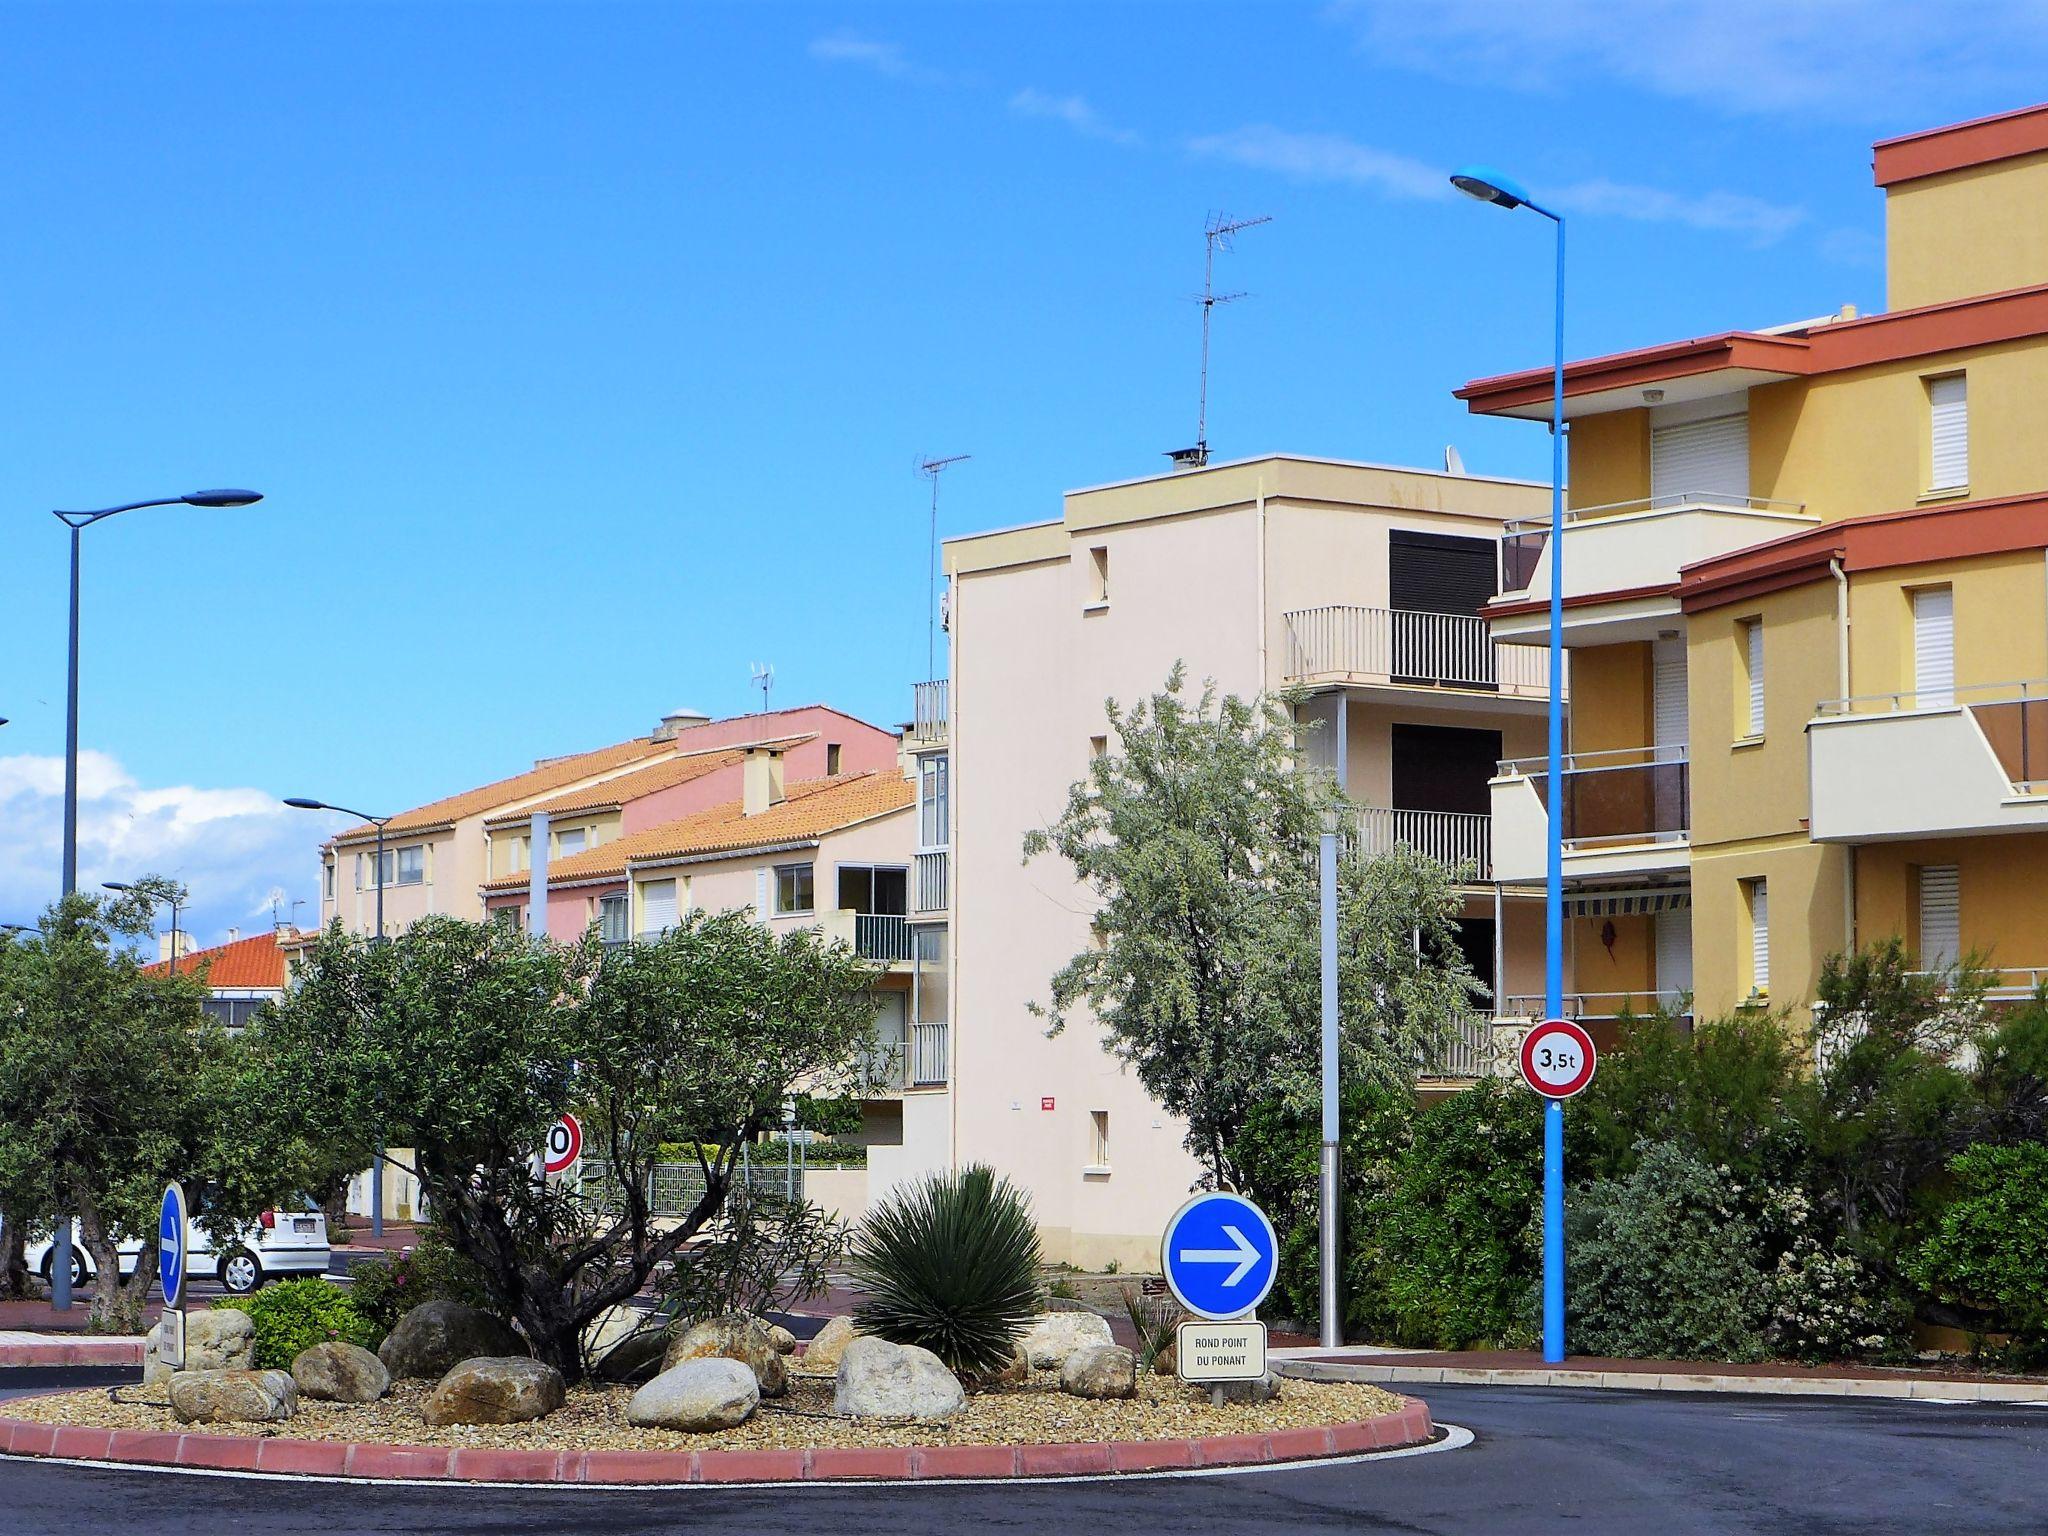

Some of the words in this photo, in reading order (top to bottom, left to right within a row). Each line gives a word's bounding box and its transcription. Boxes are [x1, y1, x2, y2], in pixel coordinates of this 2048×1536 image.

[1540, 1048, 1575, 1071] 3,5t
[545, 1126, 570, 1154] 0
[1195, 1338, 1220, 1348] ROND
[1222, 1337, 1248, 1348] POINT
[1196, 1355, 1209, 1366] DU
[1211, 1355, 1246, 1366] PONANT
